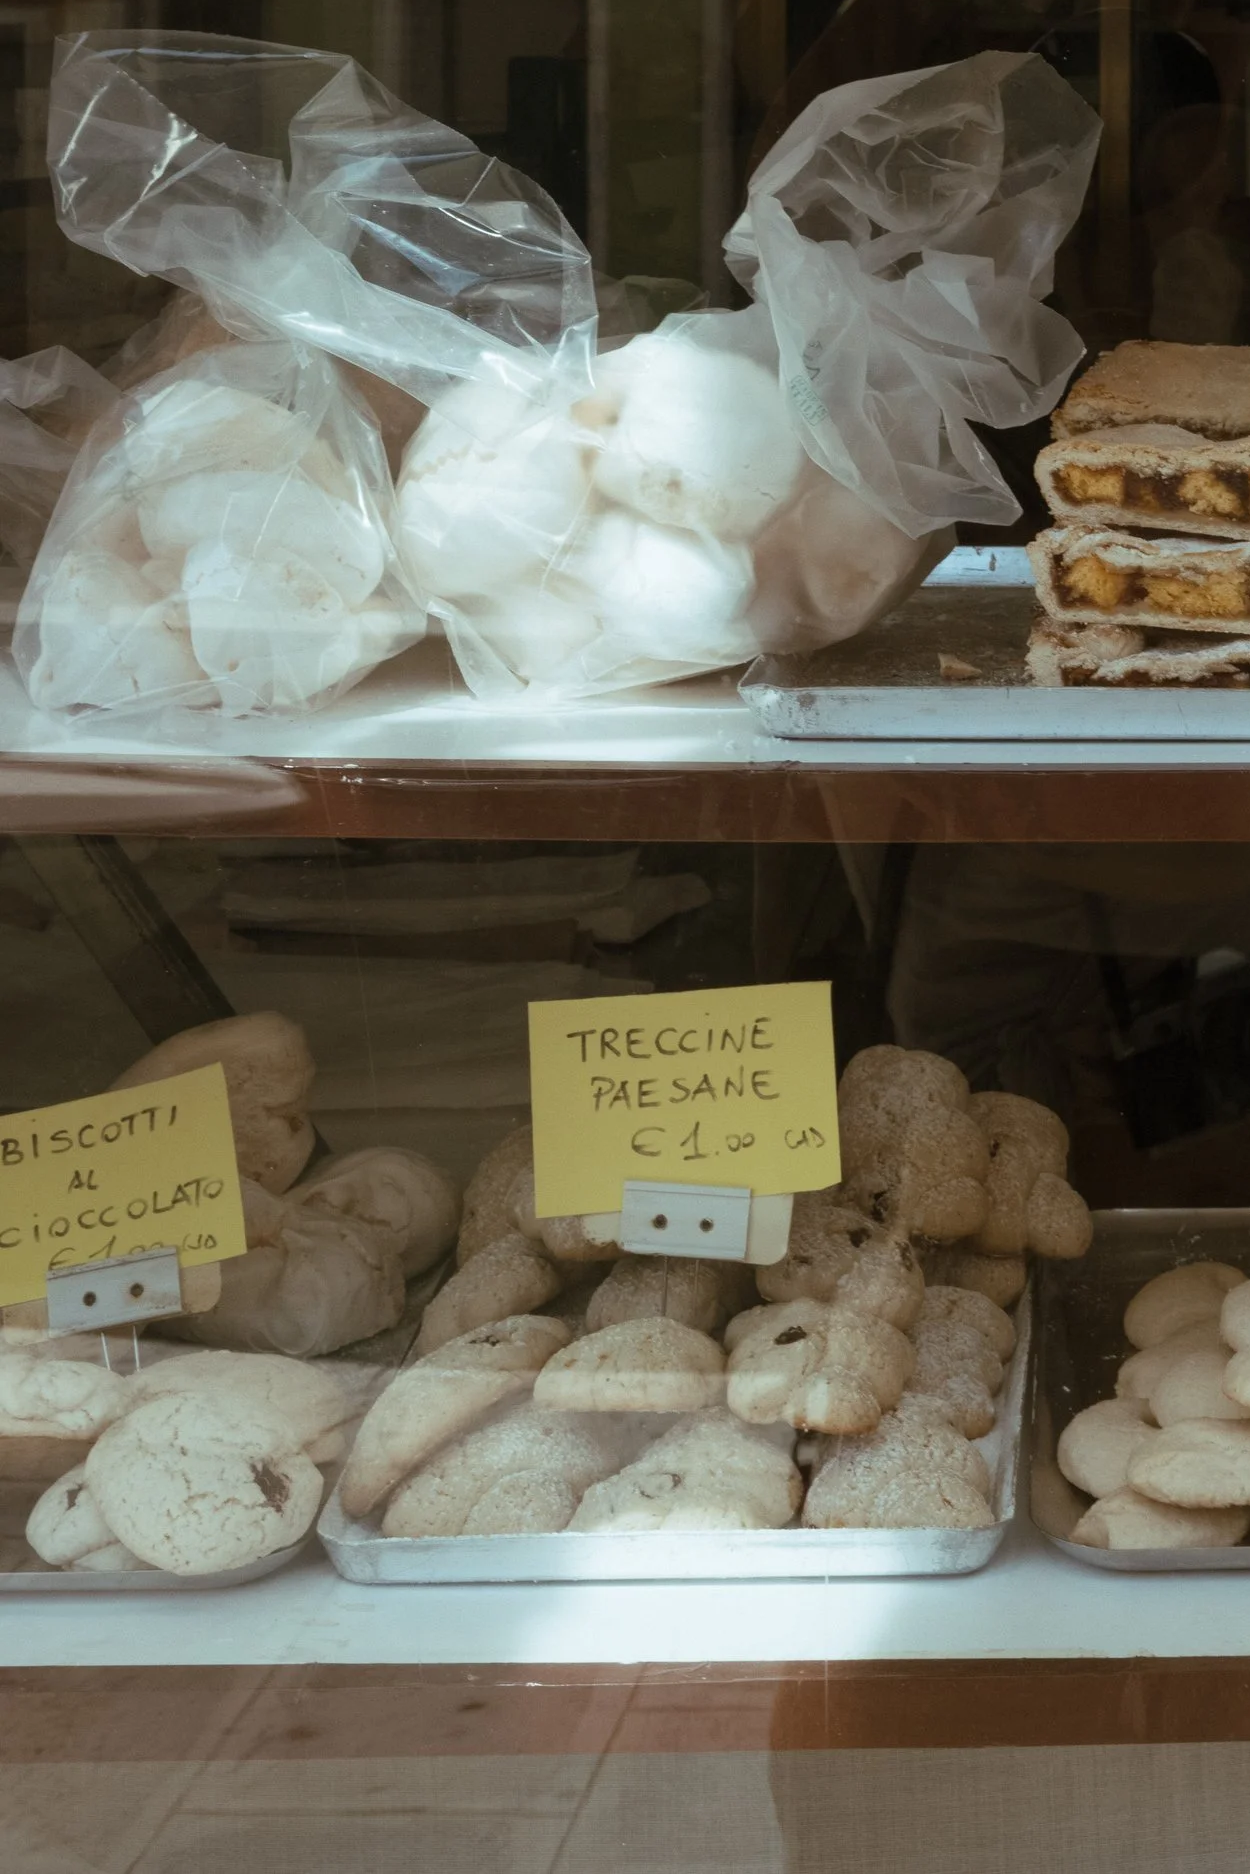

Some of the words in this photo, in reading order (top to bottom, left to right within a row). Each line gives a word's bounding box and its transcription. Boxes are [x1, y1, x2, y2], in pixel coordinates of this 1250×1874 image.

[567, 1014, 774, 1063] TRECCINE
[590, 1065, 780, 1112] PAESANE
[1, 1105, 177, 1165] BISCOTTI
[68, 1169, 99, 1193] AL
